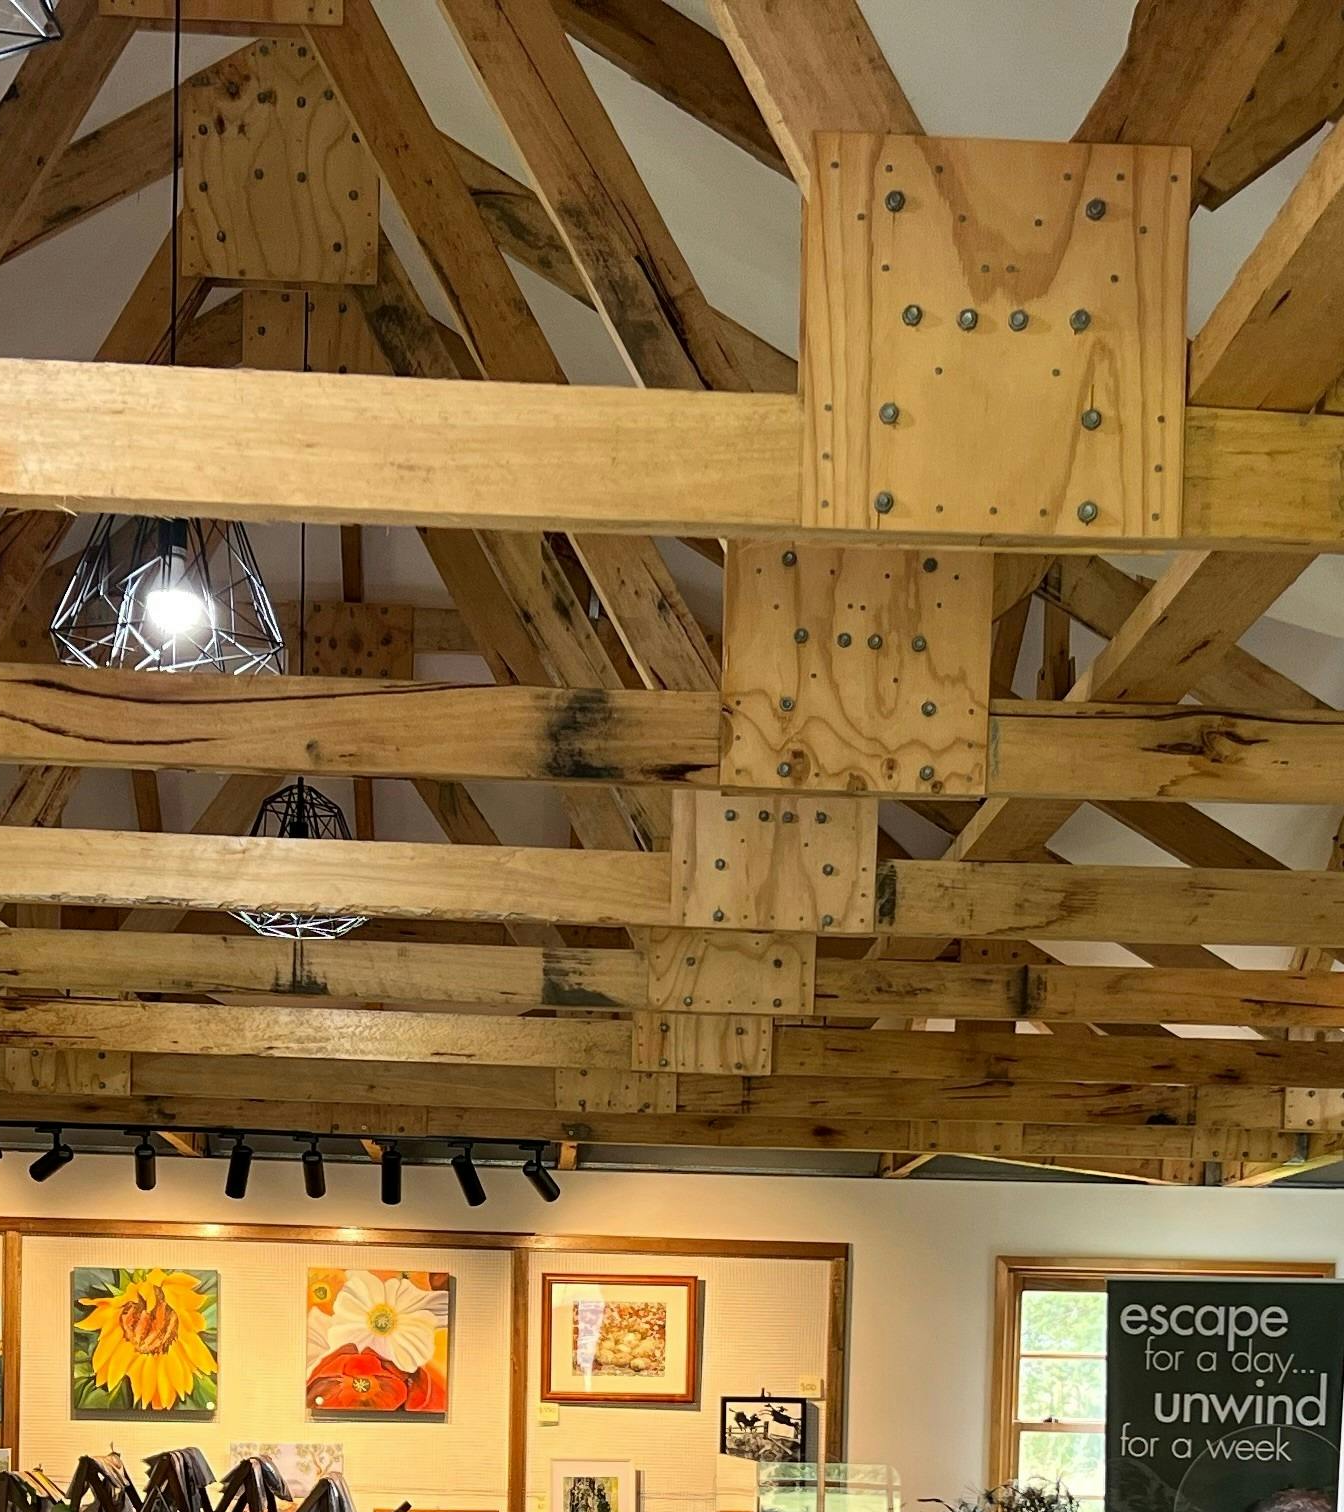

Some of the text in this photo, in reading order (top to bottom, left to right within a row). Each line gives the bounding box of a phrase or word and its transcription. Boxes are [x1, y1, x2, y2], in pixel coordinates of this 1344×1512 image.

[1120, 1304, 1289, 1351] escape
[1144, 1336, 1315, 1384] for a day...
[1155, 1373, 1327, 1426] unwind
[1120, 1422, 1292, 1462] for a week
